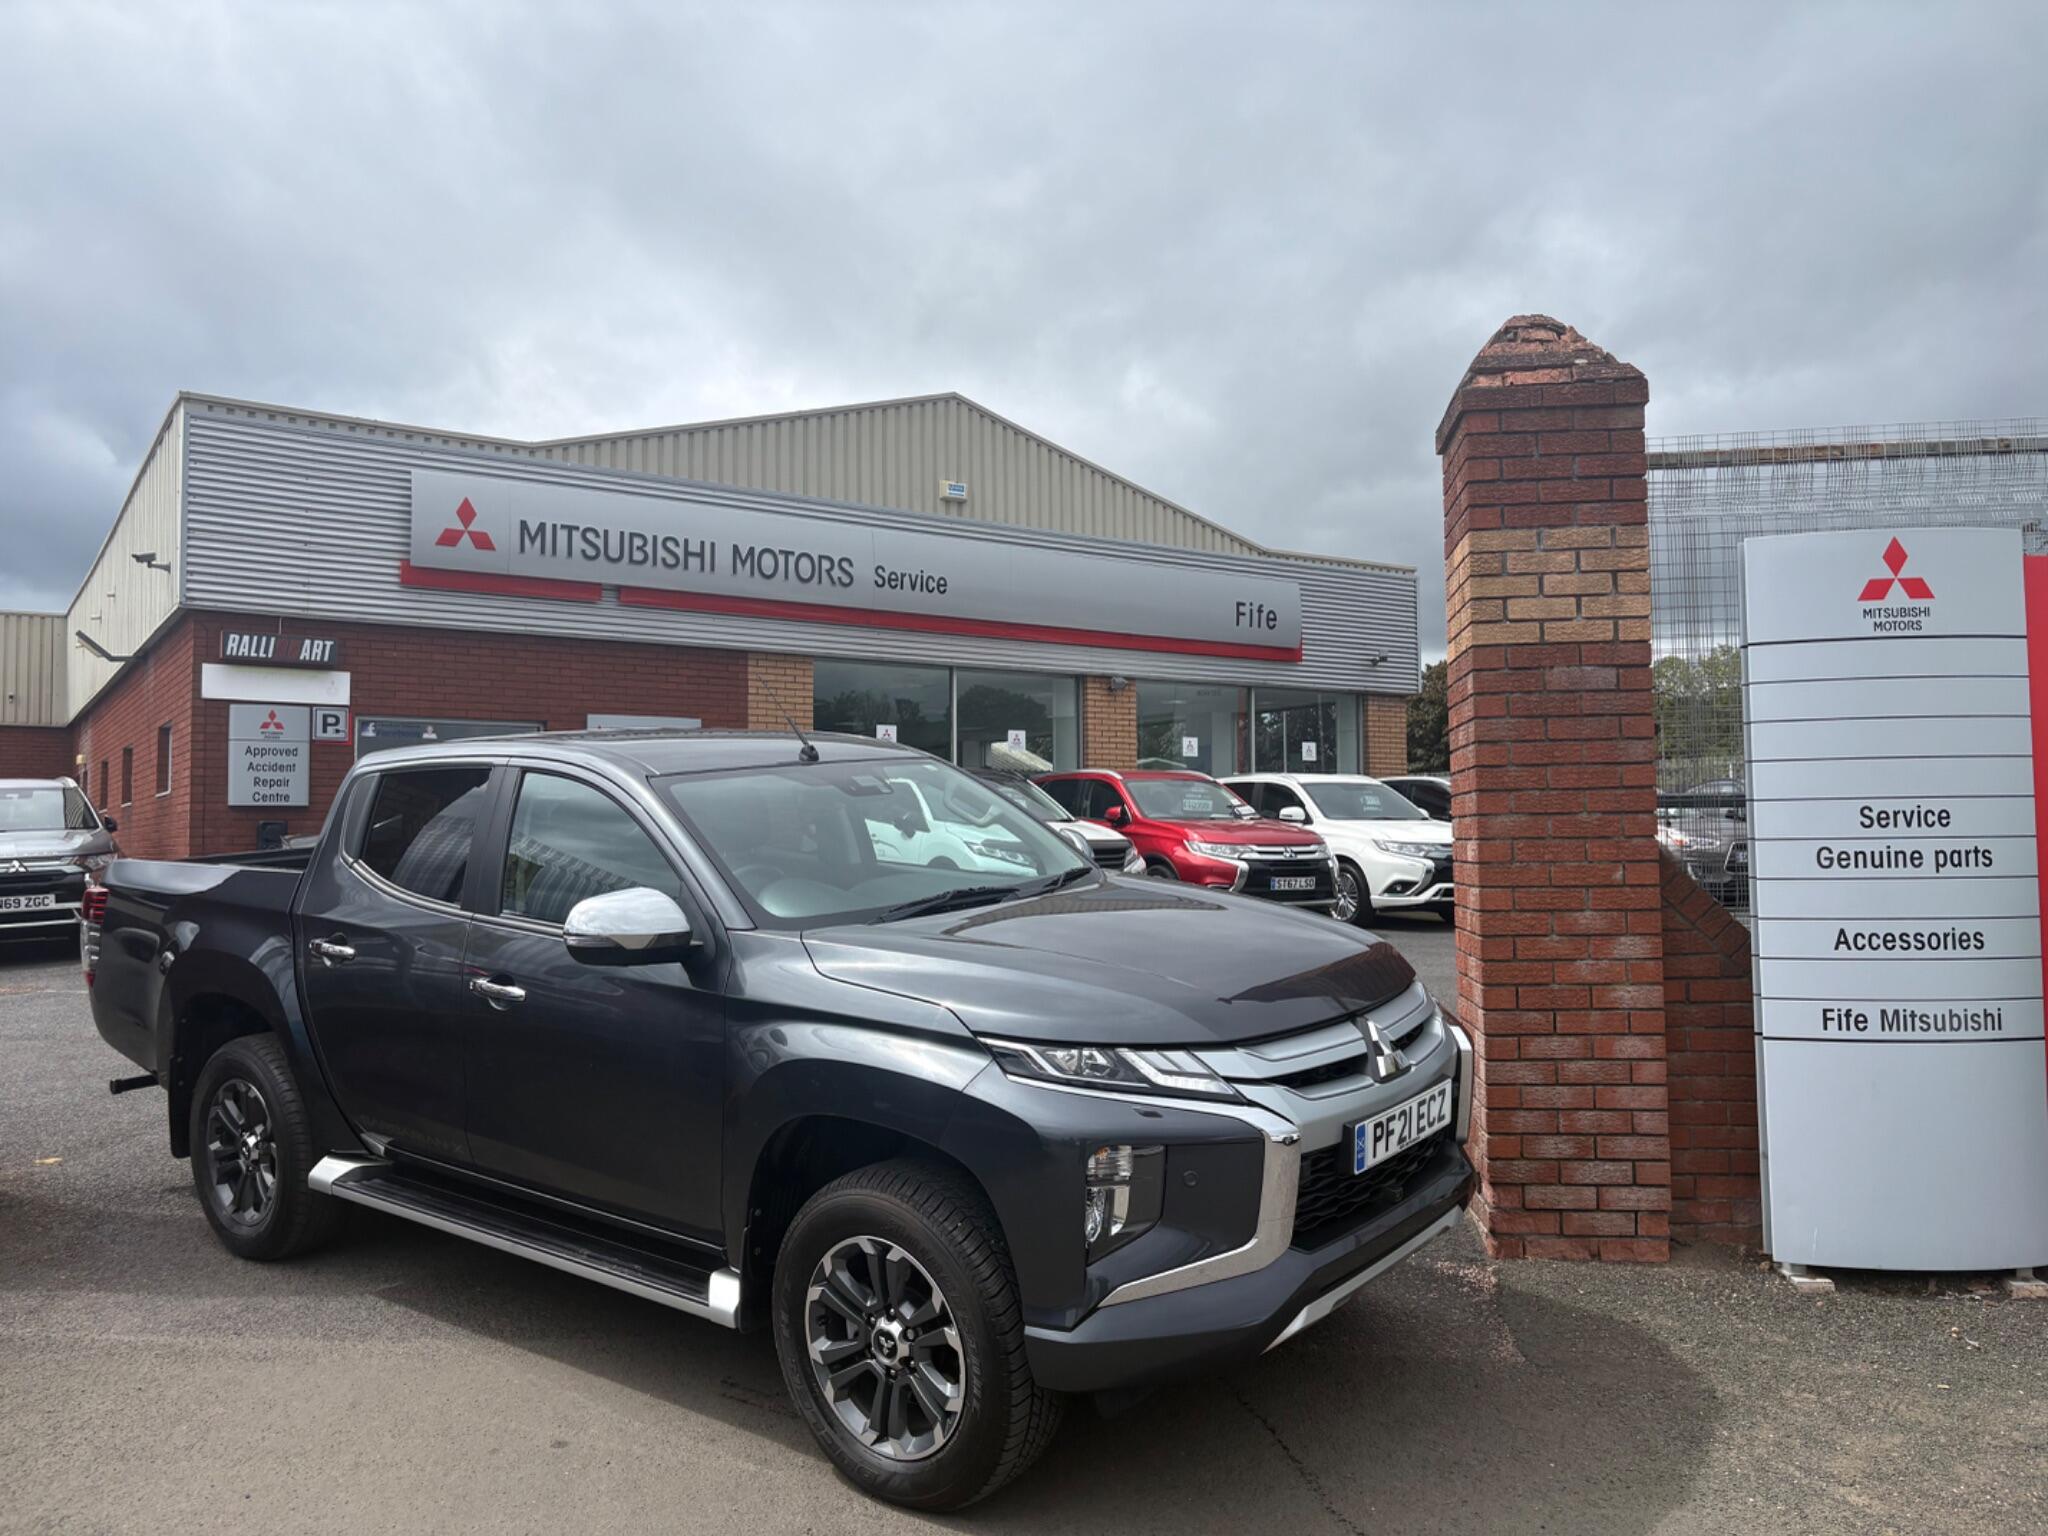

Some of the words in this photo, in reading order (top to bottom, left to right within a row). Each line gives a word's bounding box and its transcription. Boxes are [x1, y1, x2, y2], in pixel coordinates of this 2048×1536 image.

[519, 519, 715, 573] MITSUBISHI
[732, 543, 855, 588] MOTORS
[873, 565, 949, 595] Service
[1236, 601, 1278, 630] Fife
[1863, 607, 1931, 619] MITSUBISHI
[1874, 621, 1922, 631] MOTORS
[226, 634, 276, 658] RALLI
[299, 638, 334, 662] ART
[322, 713, 340, 734] P
[244, 745, 298, 758] Approved
[247, 761, 296, 772] Accident
[253, 776, 290, 789] Repair
[252, 791, 290, 803] Centre
[1859, 805, 1951, 829] Service
[1816, 845, 1923, 869] Genuine
[1935, 845, 1993, 873] parts
[25, 895, 50, 908] ZGC
[1834, 927, 1985, 951] Accessories
[1822, 1008, 1868, 1032] Fife
[1880, 1008, 2003, 1032] Mitsubishi
[1373, 1105, 1412, 1159] PF21
[1416, 1088, 1446, 1134] ECZ
